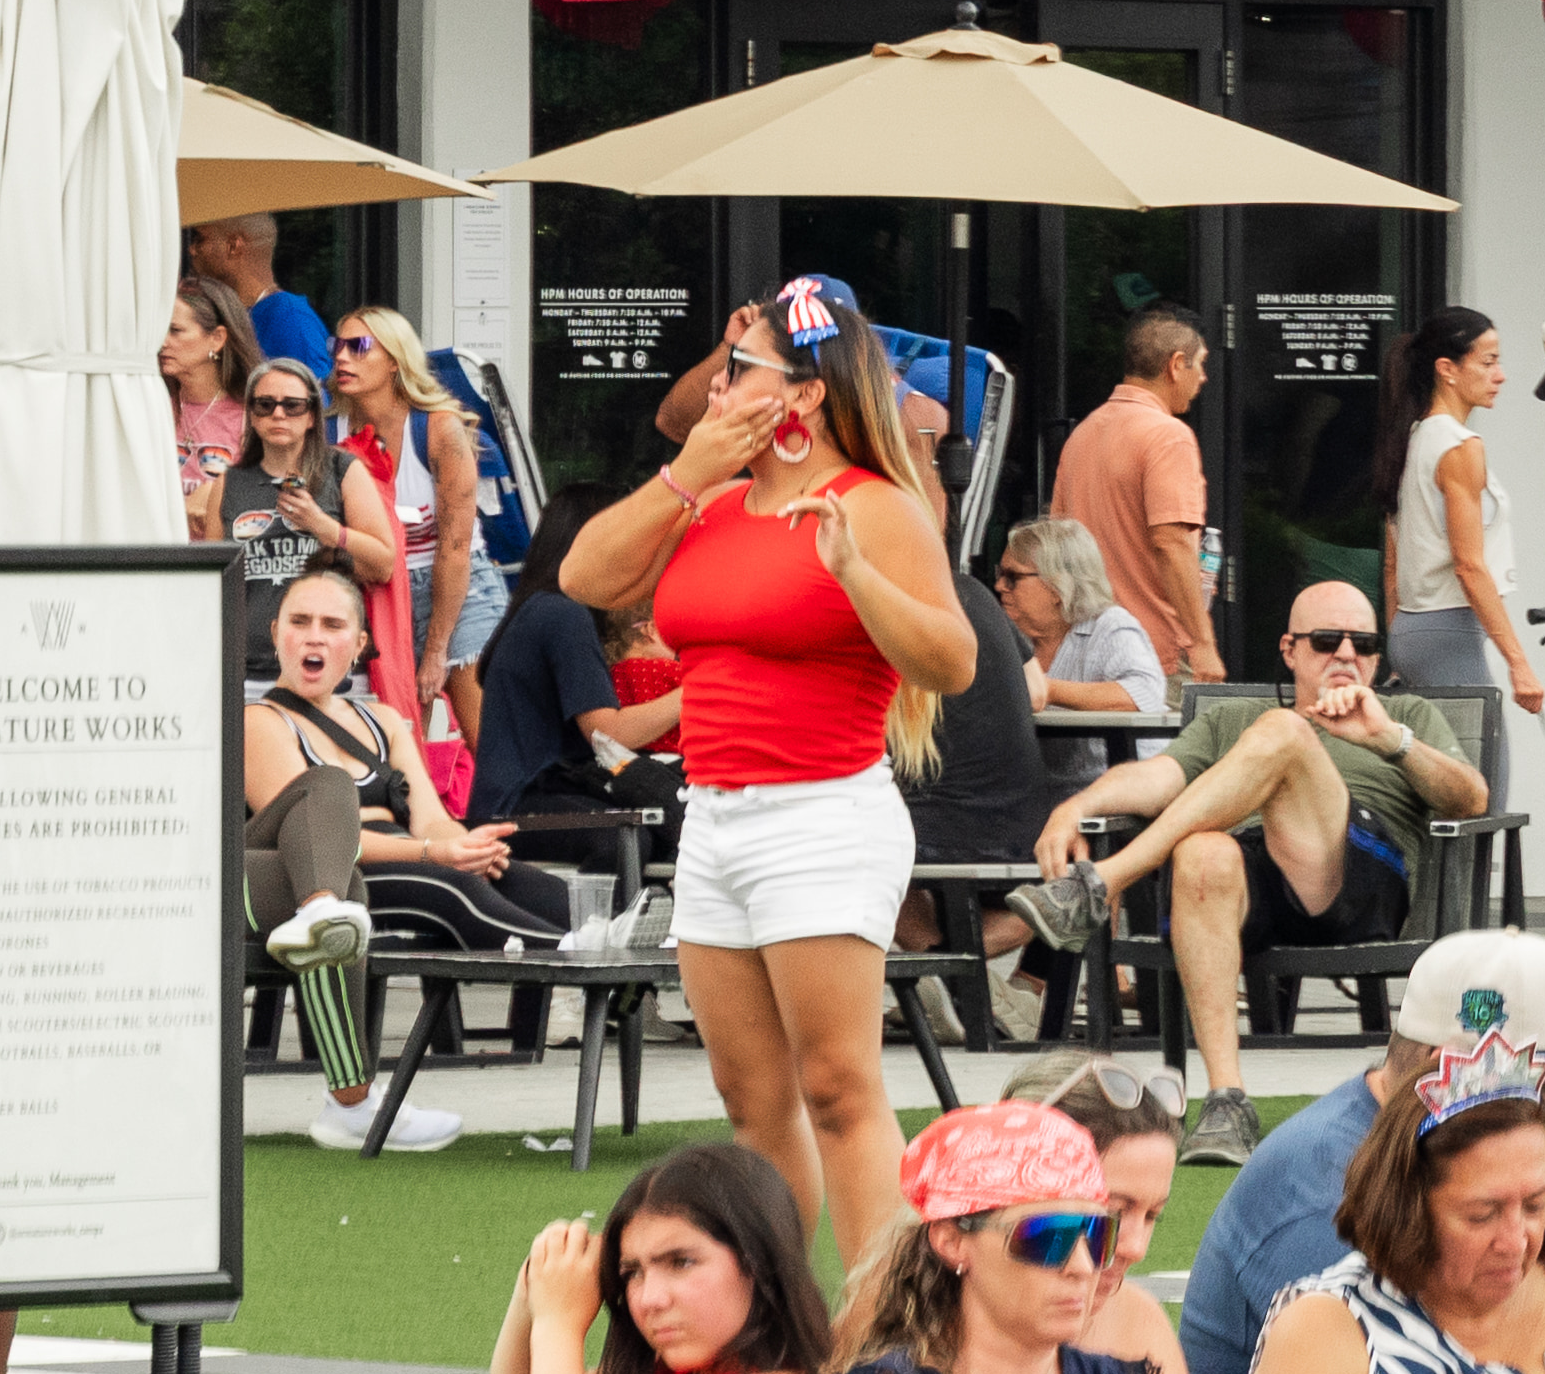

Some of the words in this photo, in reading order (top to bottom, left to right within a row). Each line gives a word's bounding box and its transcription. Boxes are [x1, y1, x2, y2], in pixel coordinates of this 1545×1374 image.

[541, 289, 564, 300] HPM
[568, 289, 605, 300] HOURS
[608, 289, 622, 300] OF
[625, 289, 689, 300] OPERATION
[1257, 294, 1280, 304] HPM
[1282, 294, 1318, 304] HOURS
[1320, 294, 1334, 304] OF
[1336, 294, 1395, 304] OPERATION
[271, 538, 293, 555] TO
[250, 556, 300, 574] GOOSE
[109, 676, 146, 702] TO
[84, 715, 182, 741] WORKS
[95, 788, 177, 805] GENERAL
[29, 820, 63, 839] ARE
[72, 817, 189, 837] PROHIBITED:
[24, 880, 48, 895] USE
[53, 879, 71, 894] OF
[75, 878, 138, 894] TOBACCO
[142, 876, 211, 892] PRODUCTS
[19, 1101, 57, 1115] BALLS
